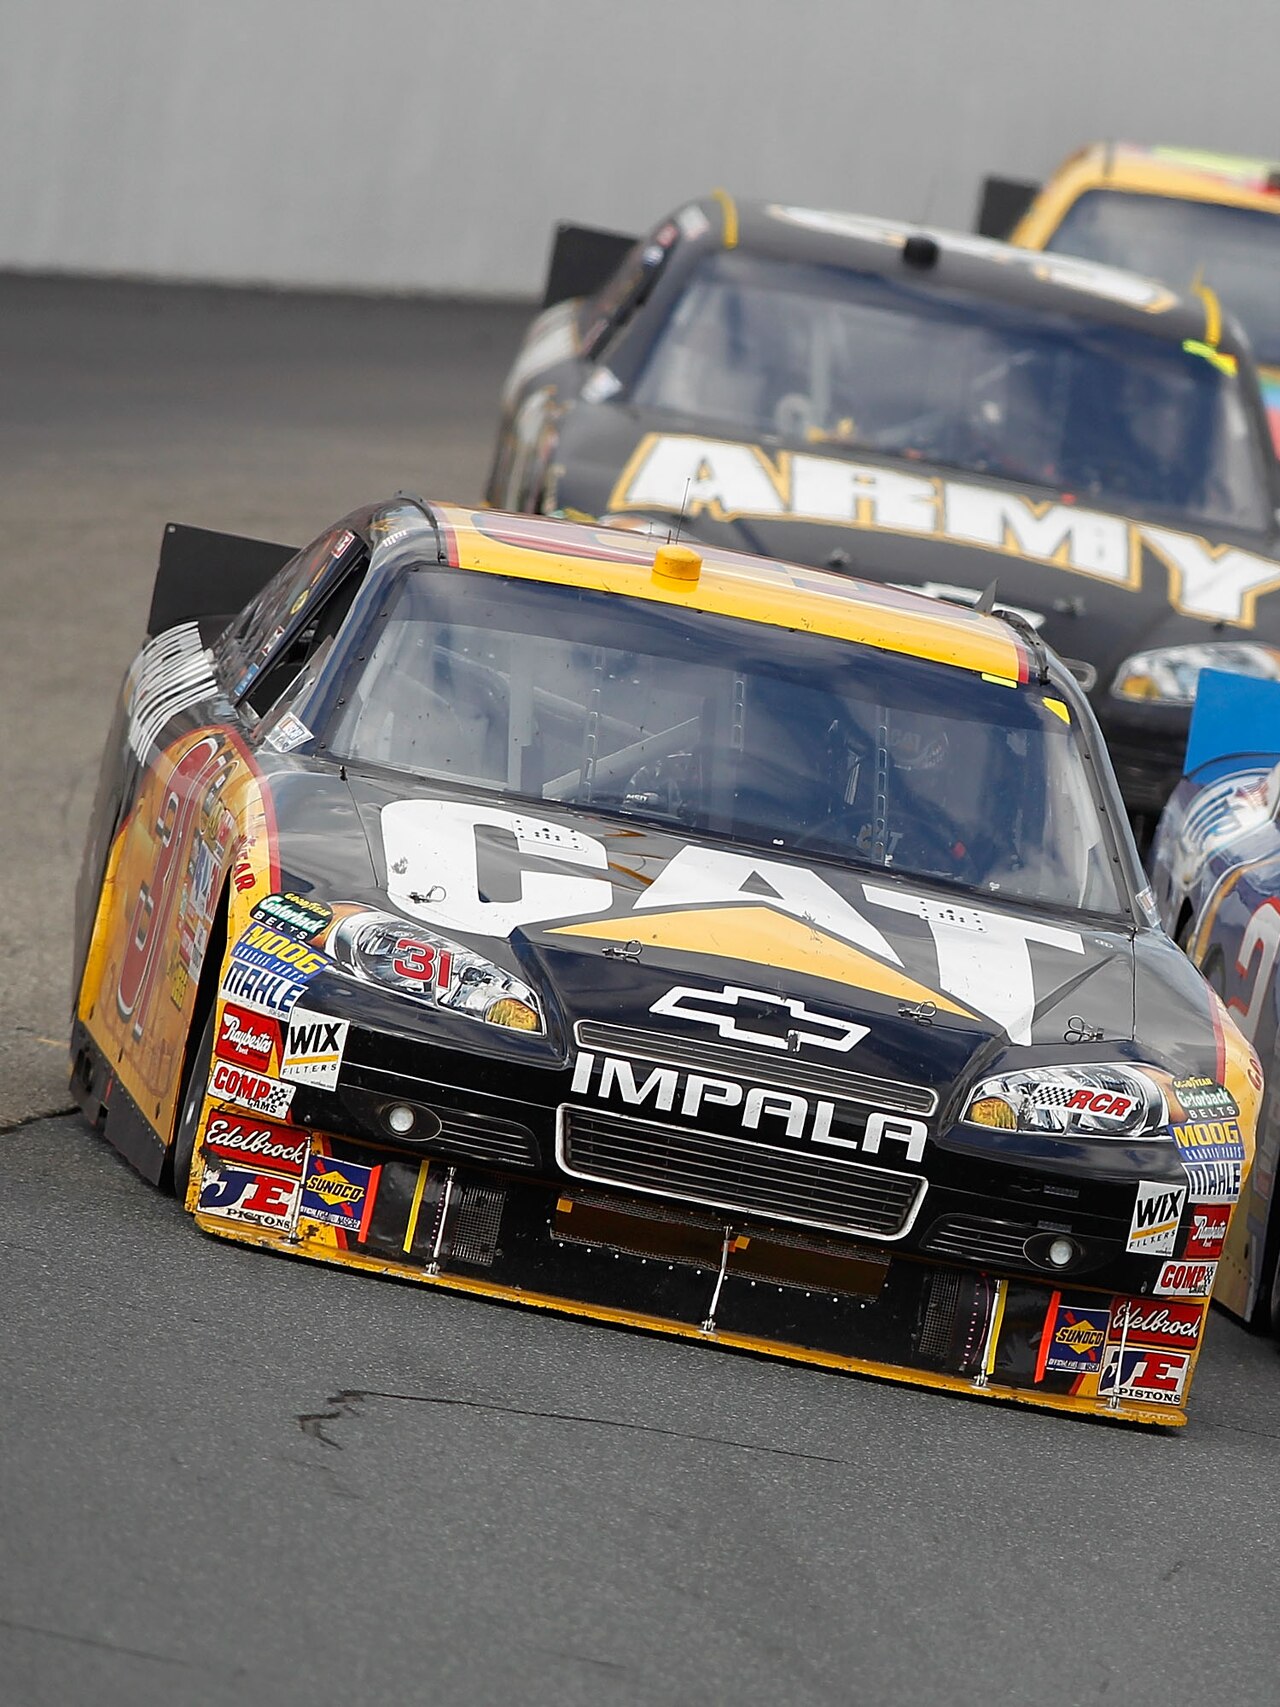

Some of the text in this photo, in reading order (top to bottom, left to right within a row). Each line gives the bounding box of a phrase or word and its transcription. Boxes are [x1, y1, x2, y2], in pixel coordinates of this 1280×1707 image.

[254, 911, 308, 941] BELTS
[258, 896, 328, 934] Gatorback
[381, 799, 1085, 1046] CAT
[240, 925, 328, 975] MOOG
[393, 938, 452, 989] 31
[223, 962, 306, 1012] MAHLE
[222, 1013, 272, 1054] Raybestos
[290, 1022, 343, 1055] WIX
[214, 1066, 271, 1102] COMP
[282, 1064, 337, 1076] FILTERS
[247, 1098, 278, 1114] CAMS
[570, 1052, 927, 1163] IMPALA
[1066, 1089, 1133, 1118] RCR
[1176, 1087, 1231, 1108] Gatorback
[1188, 1106, 1236, 1119] BELTS
[206, 1120, 304, 1165] Edelbrock
[1173, 1121, 1239, 1149] MOOG
[200, 1168, 296, 1217] JE
[308, 1176, 363, 1202] SUNOCO
[1187, 1163, 1240, 1196] MAHLE
[226, 1207, 292, 1230] PISTONS
[1137, 1188, 1184, 1228] WIX
[1128, 1230, 1176, 1249] FILTERS
[1161, 1264, 1207, 1289] COMP
[1057, 1328, 1104, 1346] SUNOCO
[1113, 1303, 1201, 1338] Edelbrock
[1100, 1350, 1184, 1392] JE
[1118, 1387, 1181, 1403] PISTONS
